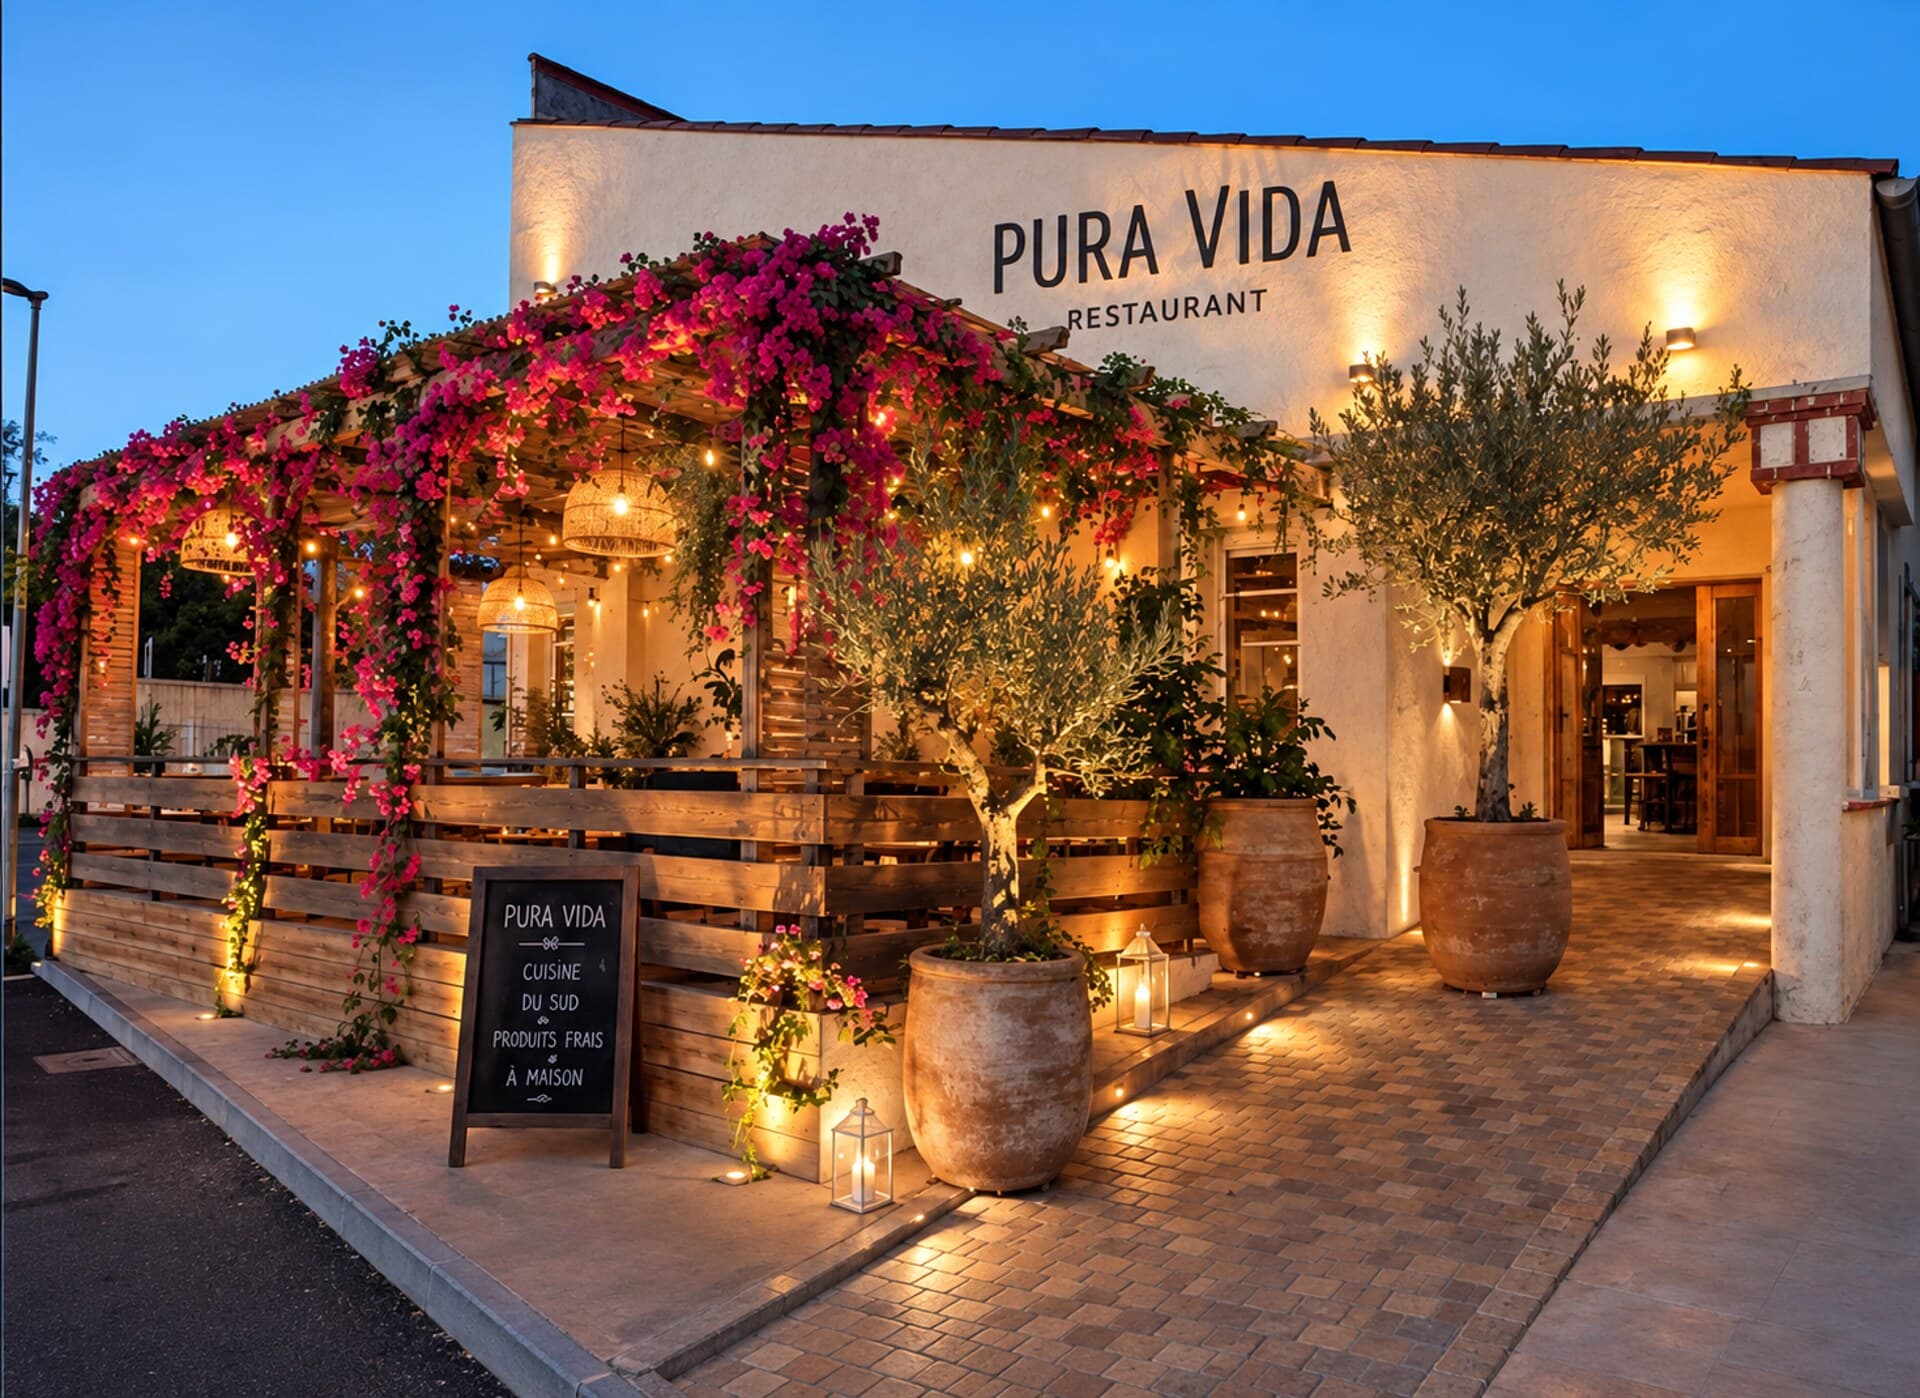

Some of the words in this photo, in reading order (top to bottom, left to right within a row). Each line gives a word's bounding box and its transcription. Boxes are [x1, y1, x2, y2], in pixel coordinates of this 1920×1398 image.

[994, 204, 1159, 294] PURA
[1185, 180, 1352, 269] VIDA
[1067, 288, 1268, 331] RESTAURANT
[503, 903, 553, 929] PURA
[562, 904, 606, 929] VIDA
[521, 993, 542, 1011] DU
[549, 993, 580, 1011] SUD
[492, 1030, 557, 1049] PRODUITS
[564, 1031, 604, 1049] FRAIS
[506, 1064, 518, 1087] À
[525, 1068, 584, 1087] MAISON
